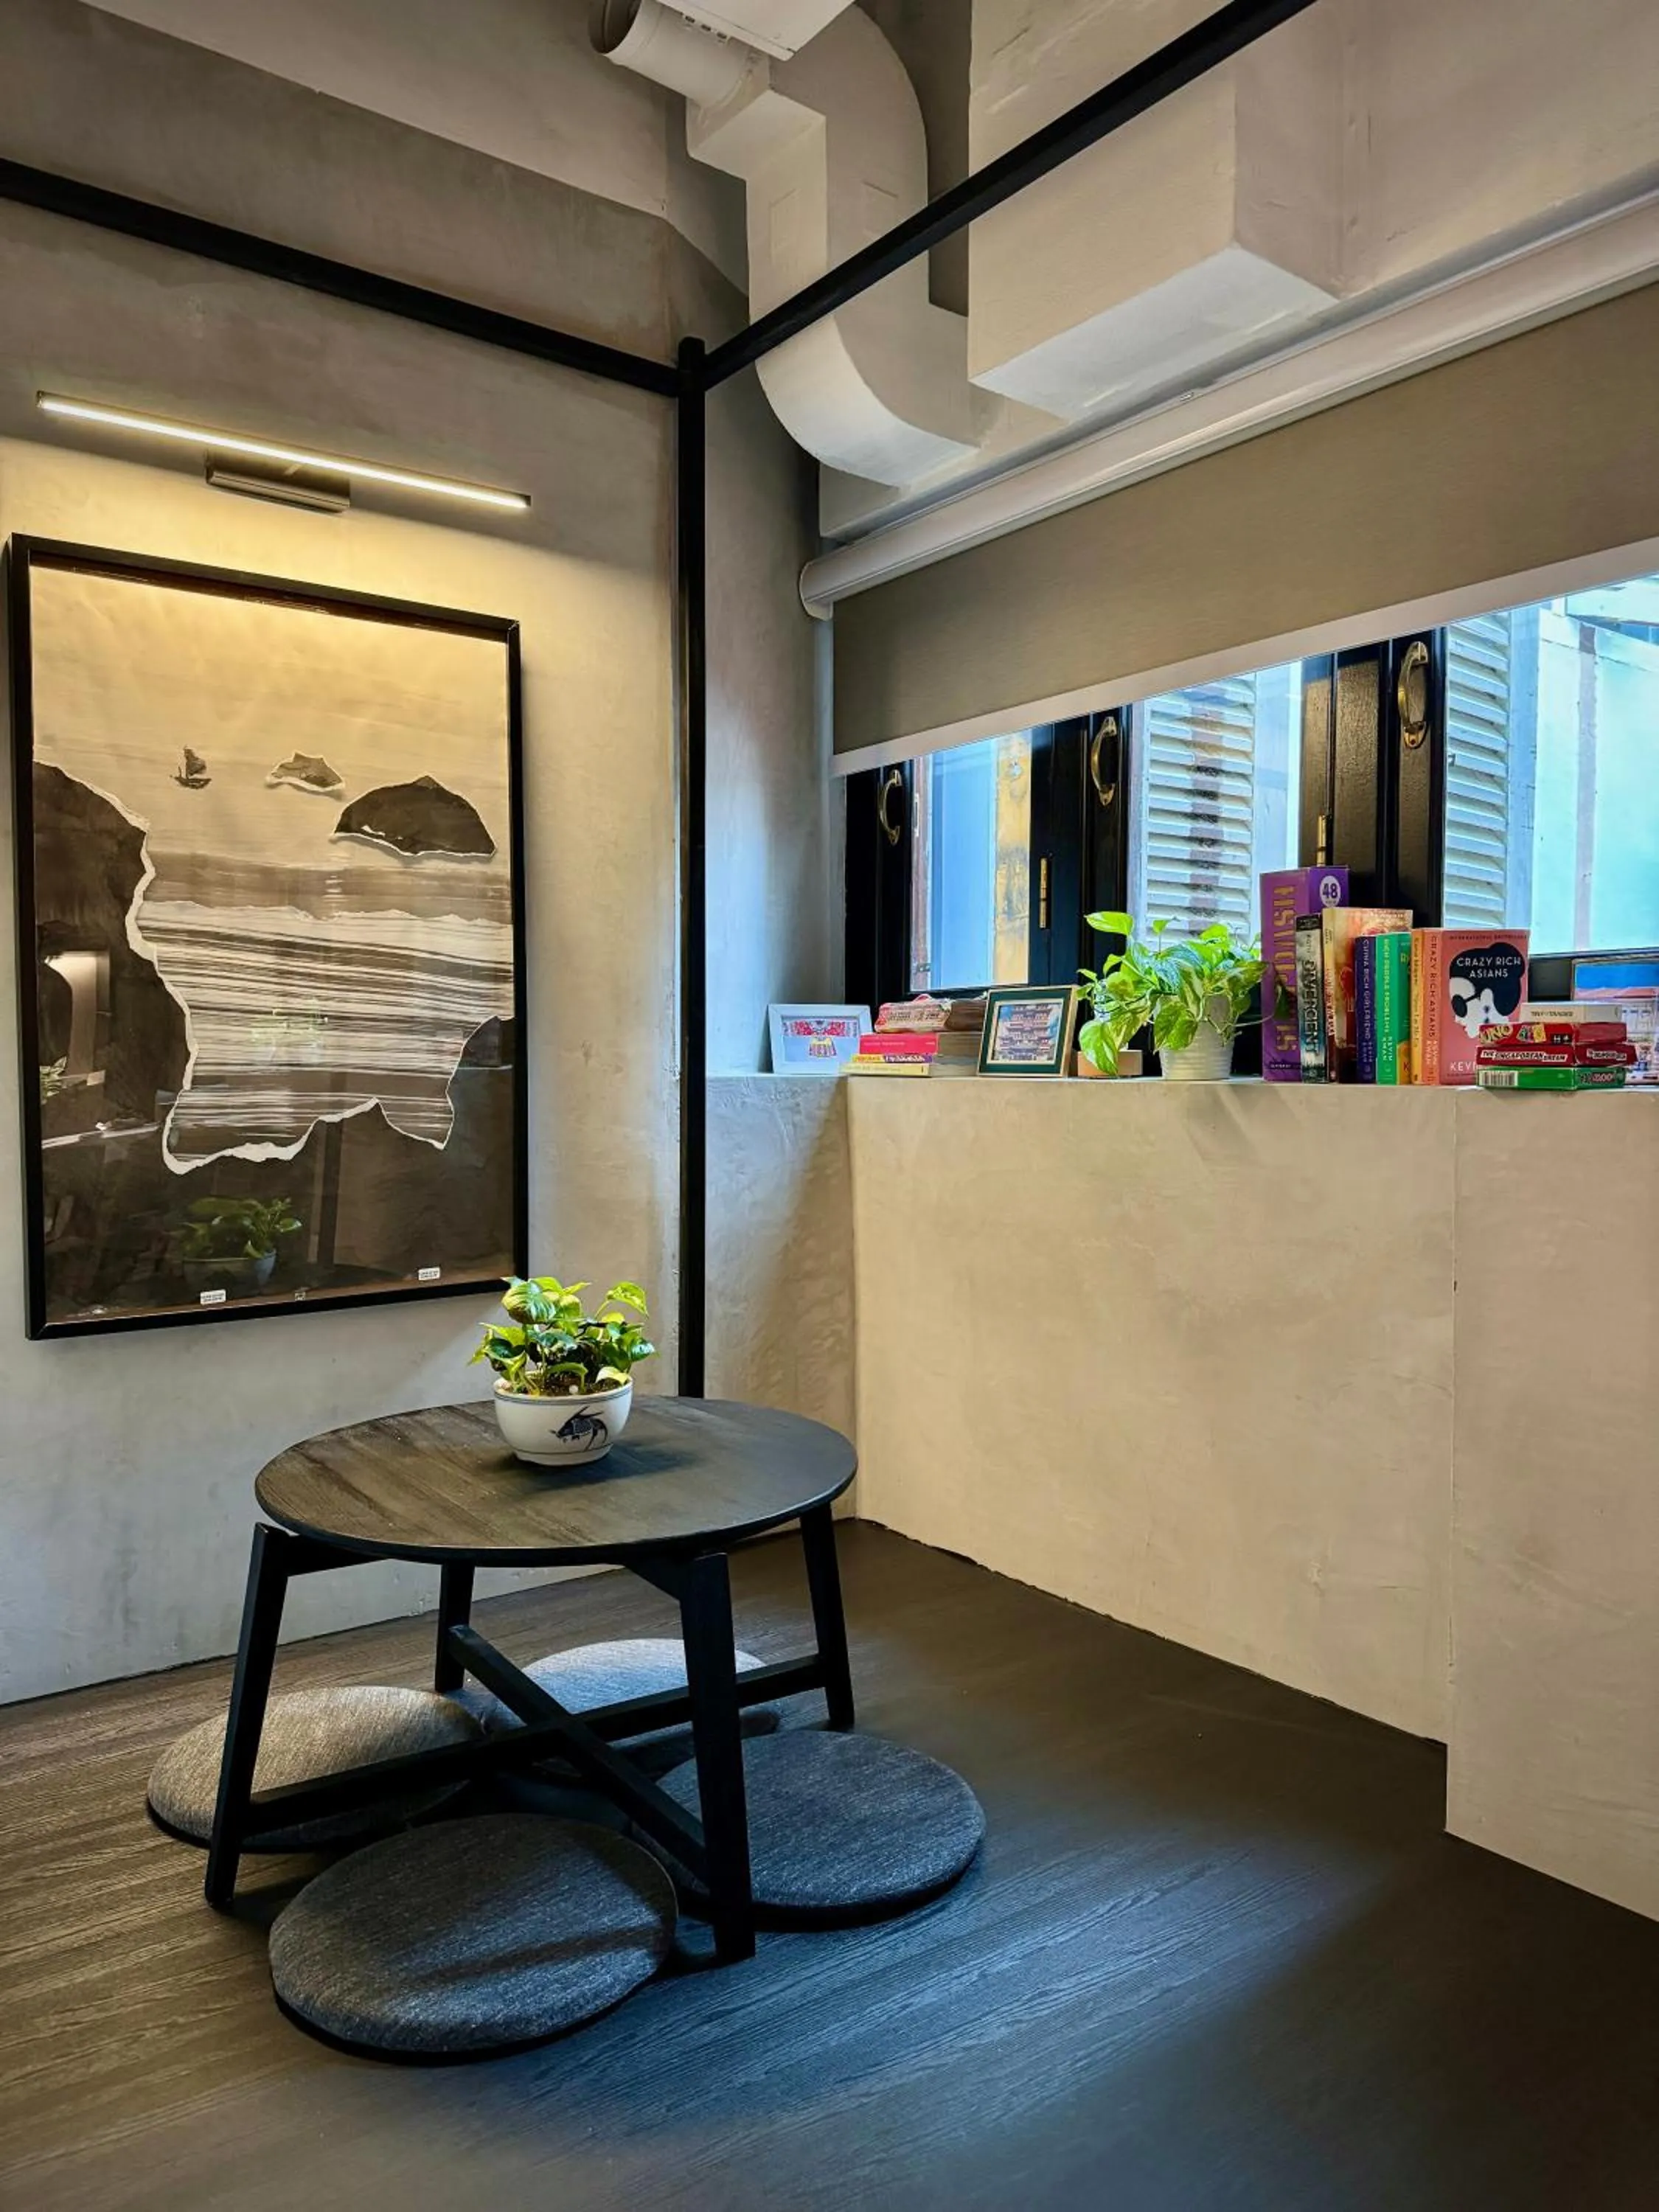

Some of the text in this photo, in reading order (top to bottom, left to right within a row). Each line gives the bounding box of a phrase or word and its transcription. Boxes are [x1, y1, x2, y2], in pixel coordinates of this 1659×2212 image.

[1323, 883, 1338, 899] 48
[1456, 956, 1521, 967] CRAZY RICH
[1469, 968, 1509, 978] ASIANS
[1303, 959, 1318, 1055] DIVERGENT
[1450, 1062, 1476, 1071] KEVI
